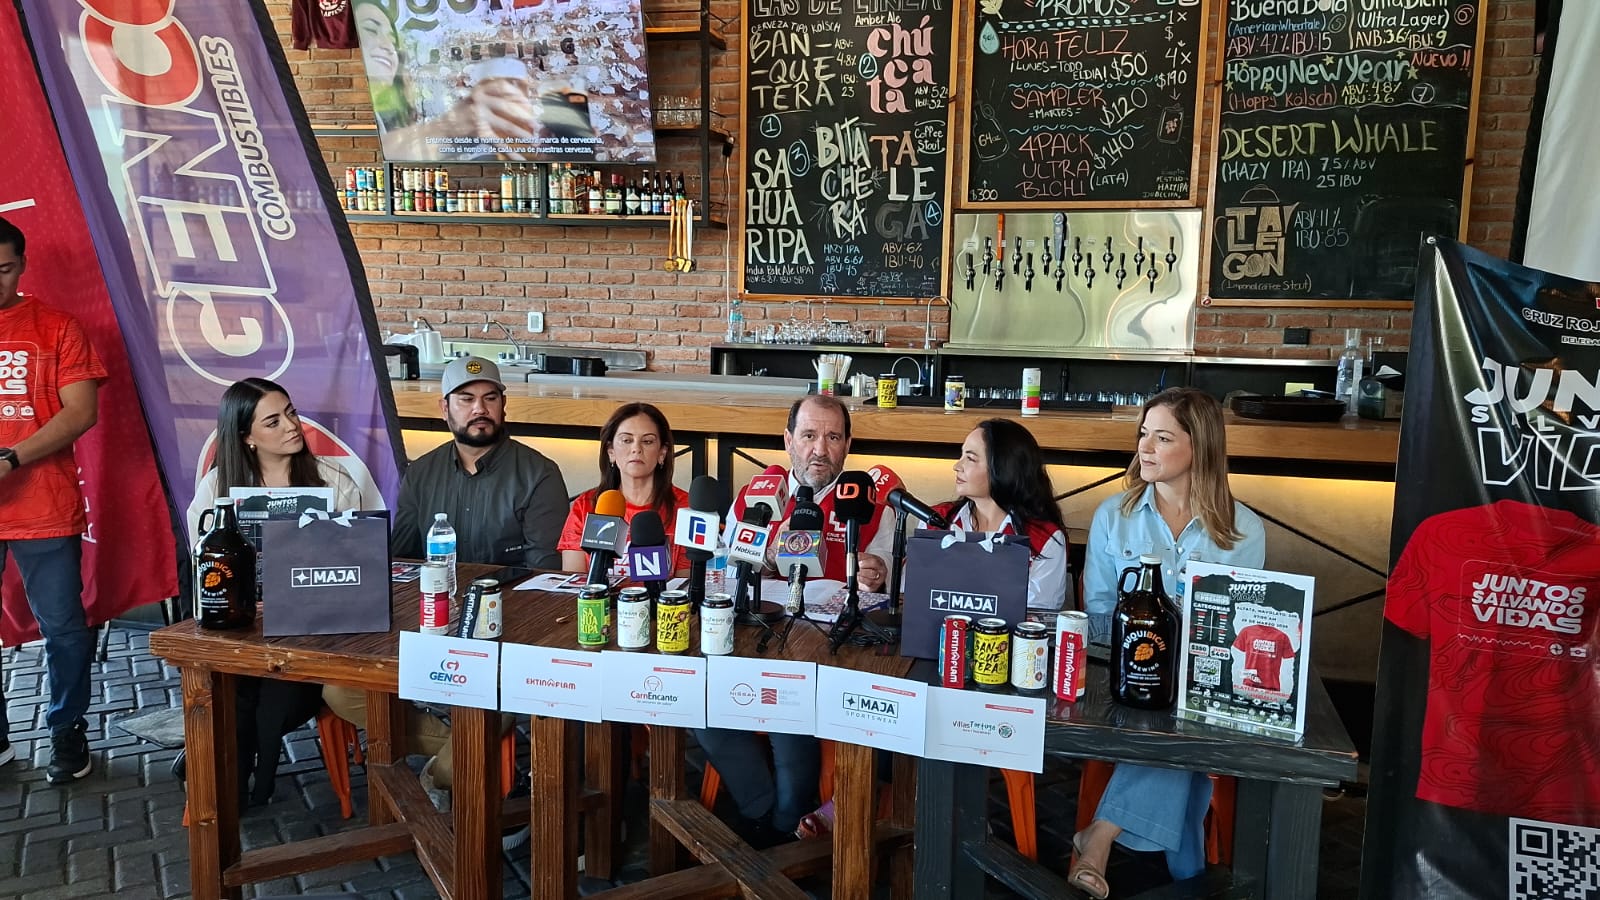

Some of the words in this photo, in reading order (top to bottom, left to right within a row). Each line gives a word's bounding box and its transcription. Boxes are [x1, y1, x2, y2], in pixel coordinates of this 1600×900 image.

[854, 14, 885, 26] Amber
[886, 11, 902, 23] Ale
[1230, 0, 1299, 21] Buena
[1400, 8, 1450, 32] Lager)
[751, 21, 789, 34] CERVEZA
[1002, 35, 1049, 60] HORA
[1053, 29, 1133, 60] FELIZ
[1436, 30, 1448, 47] 9
[1110, 52, 1148, 80] $50
[1411, 52, 1458, 67] NUEVO
[751, 81, 835, 110] TERA
[841, 86, 855, 98] 23
[1011, 87, 1106, 110] SAMPLER
[1101, 87, 1148, 128] $120
[204, 38, 294, 238] COMBUSTIBLES
[454, 137, 472, 145] desde
[481, 137, 504, 145] nombre
[506, 137, 514, 145] de
[561, 137, 570, 145] de
[915, 126, 944, 139] Coffee
[1221, 122, 1327, 160] DESERT
[1331, 115, 1438, 154] WHALE
[463, 146, 487, 154] nombre
[488, 146, 497, 154] de
[498, 146, 513, 154] cada
[869, 131, 919, 172] TA
[918, 139, 941, 151] Stout
[1093, 132, 1135, 170] $140
[752, 149, 793, 189] SA
[1022, 160, 1090, 179] ULTRA
[1222, 161, 1270, 183] (HAZY
[1282, 160, 1311, 181] IPA)
[1353, 158, 1377, 170] ABV
[888, 166, 936, 201] LE
[1090, 168, 1130, 191] (LATA)
[1316, 174, 1336, 188] 25
[1340, 174, 1362, 187] IBU
[1015, 180, 1087, 199] BICHI
[747, 189, 804, 225] HUA
[875, 202, 930, 241] GA
[746, 229, 815, 264] RIPA
[846, 244, 860, 254] IPA
[1521, 307, 1564, 328] CRUZ
[267, 498, 298, 509] JUNTOS
[794, 508, 818, 518] RODE
[734, 545, 761, 557] Noticias
[313, 569, 357, 584] MAJA
[1228, 583, 1267, 591] JUNTOS
[1472, 573, 1588, 604] JUNTOS
[951, 595, 994, 611] MAJA
[1472, 590, 1585, 617] SALVANDO
[1472, 604, 1582, 635] VIDAS
[1123, 630, 1166, 651] BUQUIBICHI
[1129, 661, 1159, 672] BREWING
[429, 671, 467, 684] GENCO
[630, 690, 679, 702] CarnEncanto
[730, 690, 757, 698] NISSAN
[861, 698, 896, 715] MAJA
[845, 710, 897, 725] SPORTSWEAR
